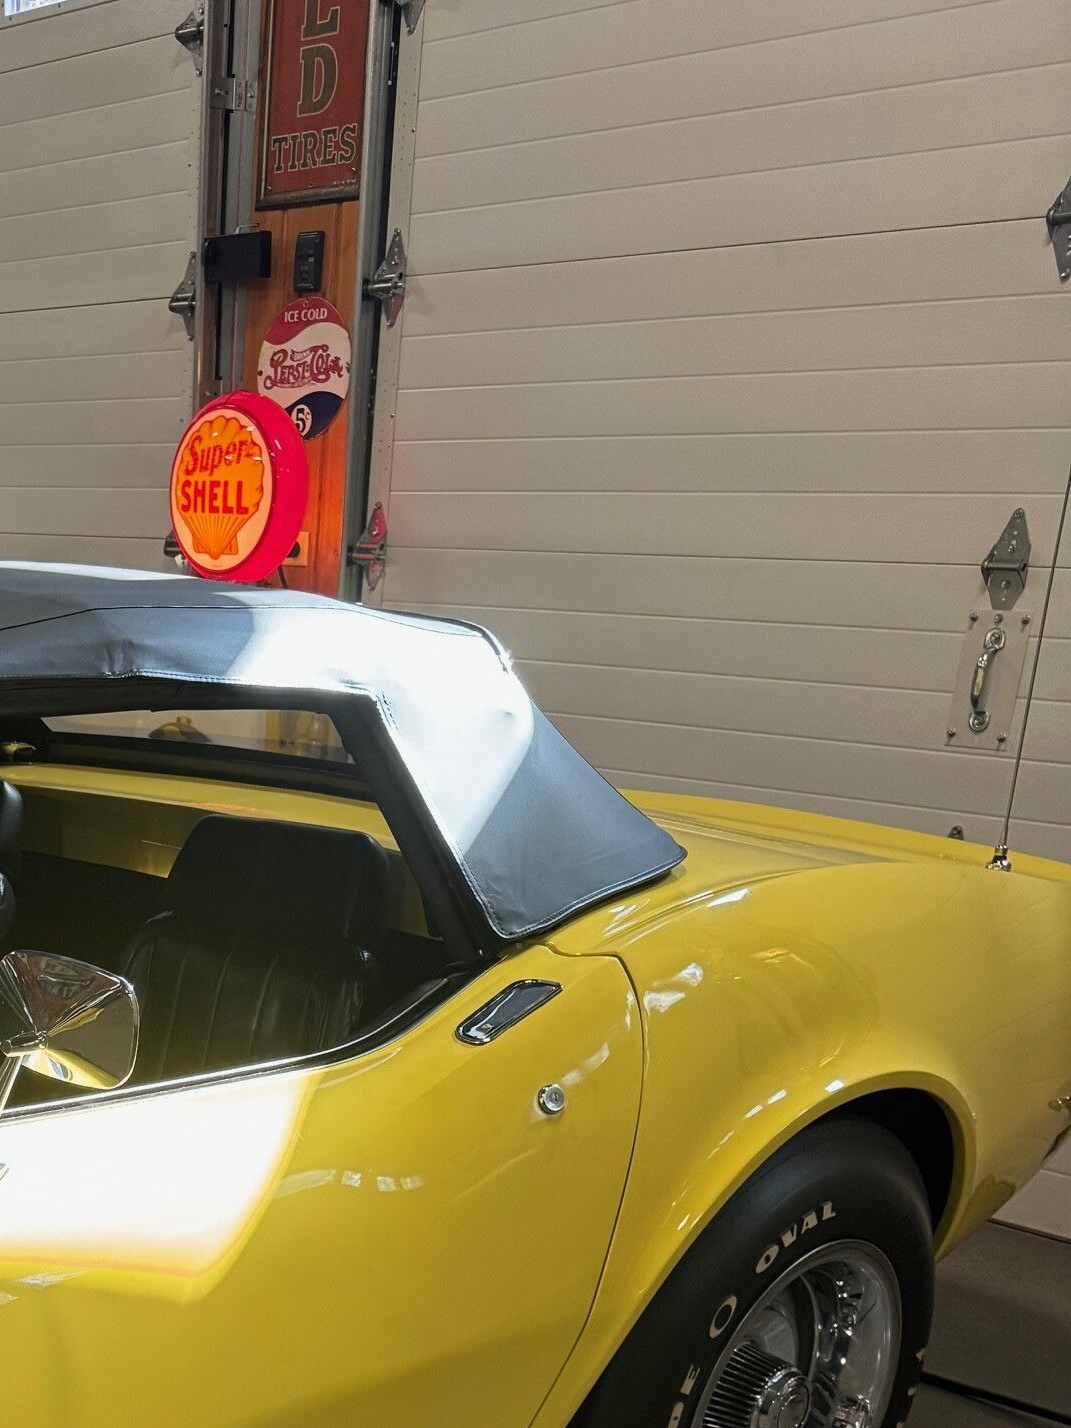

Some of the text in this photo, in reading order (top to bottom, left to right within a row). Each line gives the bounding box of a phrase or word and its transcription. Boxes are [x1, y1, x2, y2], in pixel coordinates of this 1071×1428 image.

[271, 122, 358, 174] TIRES
[284, 308, 328, 323] ICE COLD
[184, 434, 251, 476] Super
[180, 479, 250, 515] SHELL
[755, 1200, 837, 1275] OVAL
